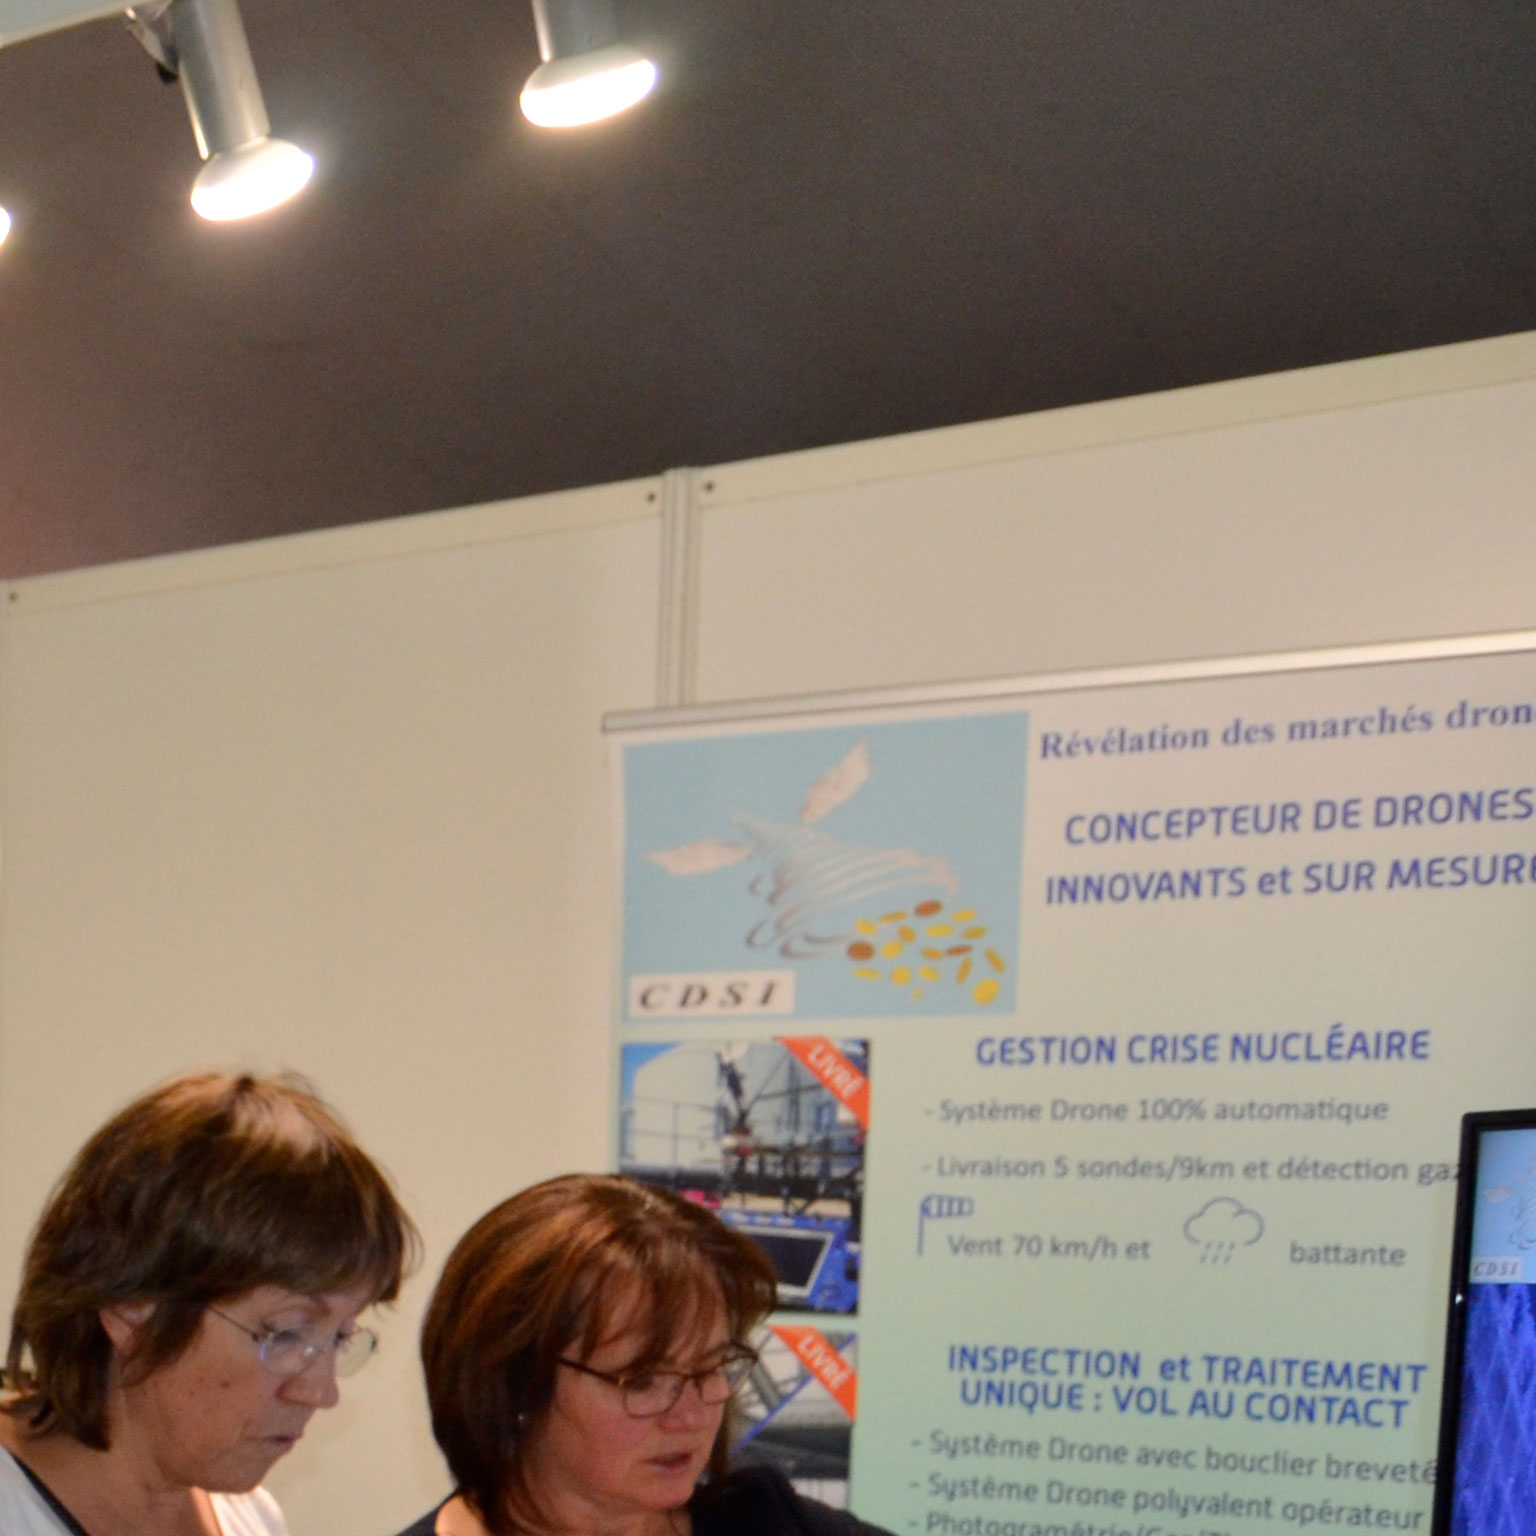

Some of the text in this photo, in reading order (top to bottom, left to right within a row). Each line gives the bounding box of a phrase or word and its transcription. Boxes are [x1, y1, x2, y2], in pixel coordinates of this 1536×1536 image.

[1040, 724, 1210, 759] Révélation
[1221, 718, 1275, 746] des
[1288, 705, 1433, 741] marchés
[1065, 788, 1534, 846] CONCEPTEUR DE DRONES
[1046, 867, 1247, 905] INNOVANTS
[1257, 865, 1292, 896] et
[1303, 860, 1375, 894] SUR
[639, 980, 778, 1012] CDSI
[975, 1023, 1430, 1066] GESTION CRISE NUCLÉAIRE
[939, 1099, 1388, 1127] Système Drone 100% automatique
[937, 1157, 1045, 1178] Livraison
[1055, 1158, 1068, 1178] 5
[1077, 1156, 1235, 1182] sondes/9km
[1243, 1159, 1269, 1180] et
[1278, 1157, 1408, 1182] détection
[947, 1234, 1406, 1268] Vent 70 km/h et battante
[1473, 1261, 1519, 1277] CDSI
[948, 1344, 1428, 1394] INSPECTION et TRAITEMENT
[960, 1379, 1409, 1429] UNIQUE VOL AU CONTACT
[928, 1430, 1040, 1461] Système
[1049, 1436, 1127, 1464] Drone
[1136, 1445, 1197, 1467] avec
[1205, 1444, 1317, 1477] bouclier
[928, 1474, 1425, 1530] Système Drone polyvalent opérateur
